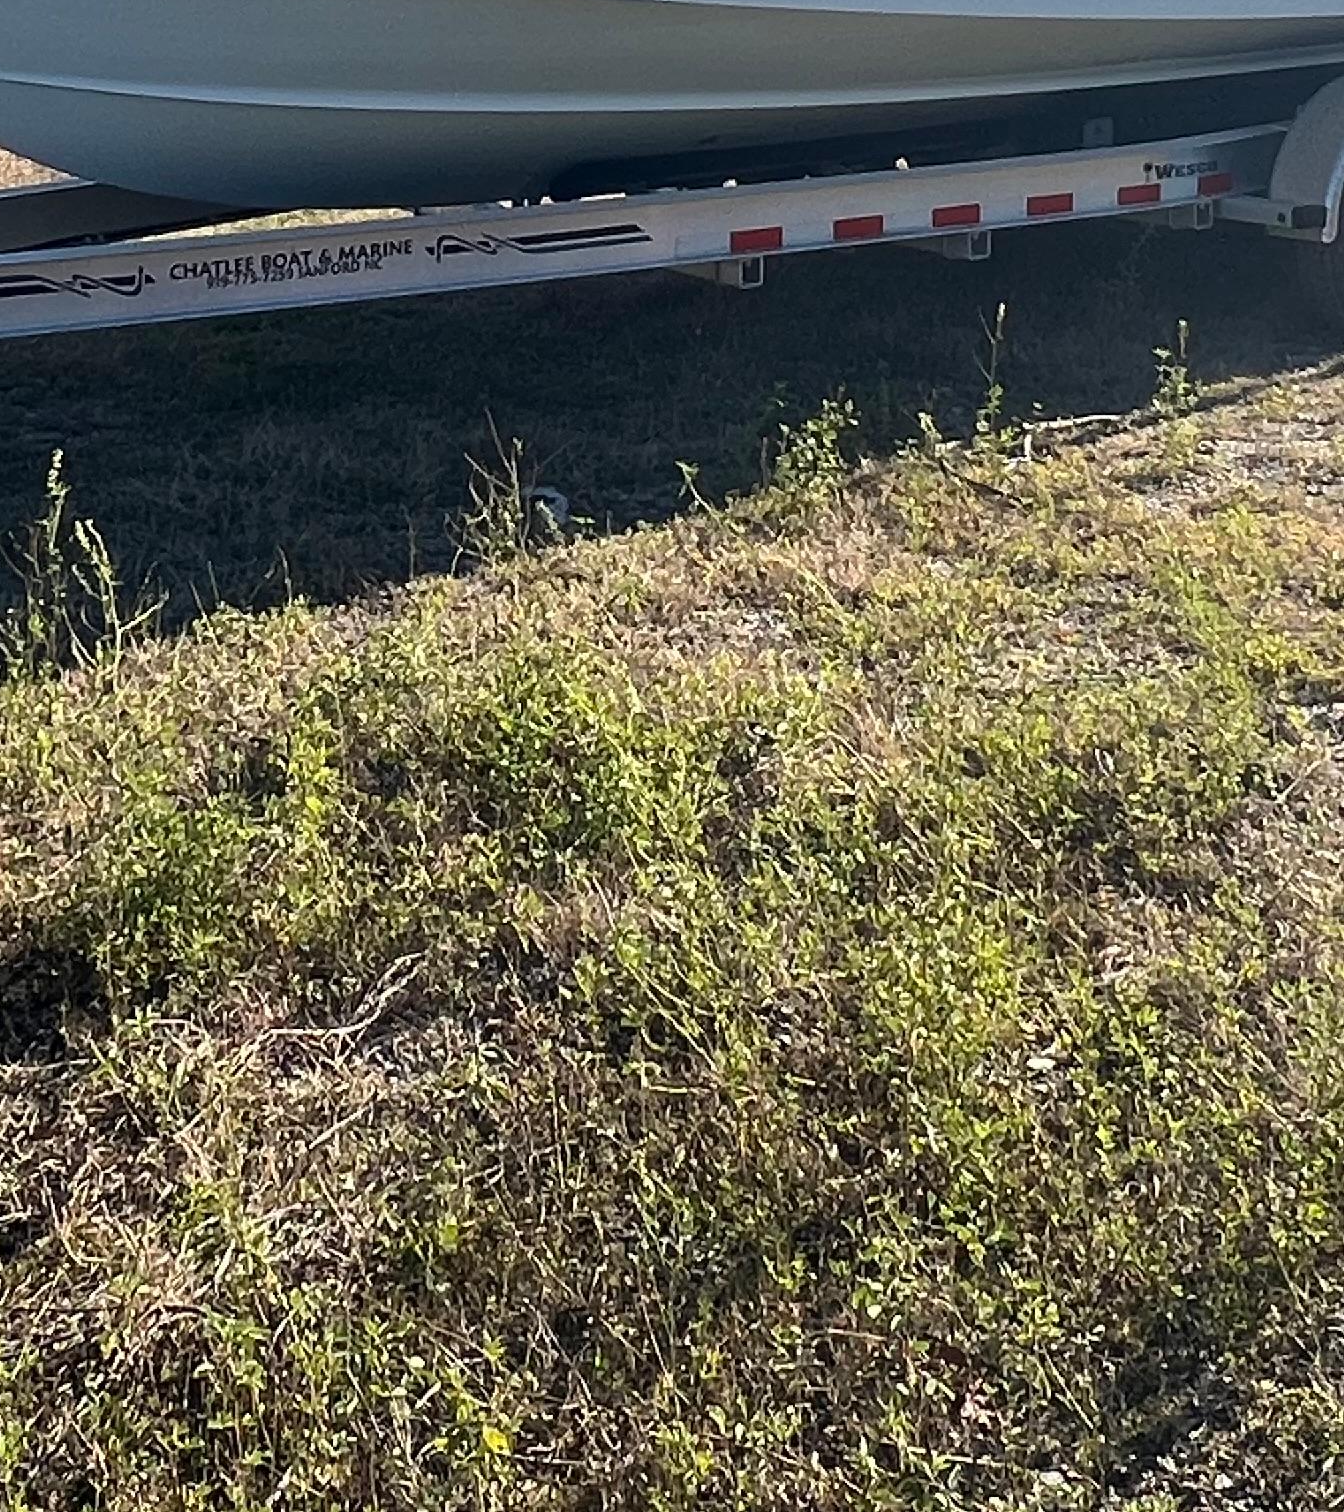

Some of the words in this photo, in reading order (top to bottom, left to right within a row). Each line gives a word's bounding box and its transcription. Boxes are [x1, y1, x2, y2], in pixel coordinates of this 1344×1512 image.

[170, 256, 254, 280] CHATLEE
[261, 249, 313, 270] BOAT
[319, 248, 333, 264] &
[338, 239, 413, 262] MARINE
